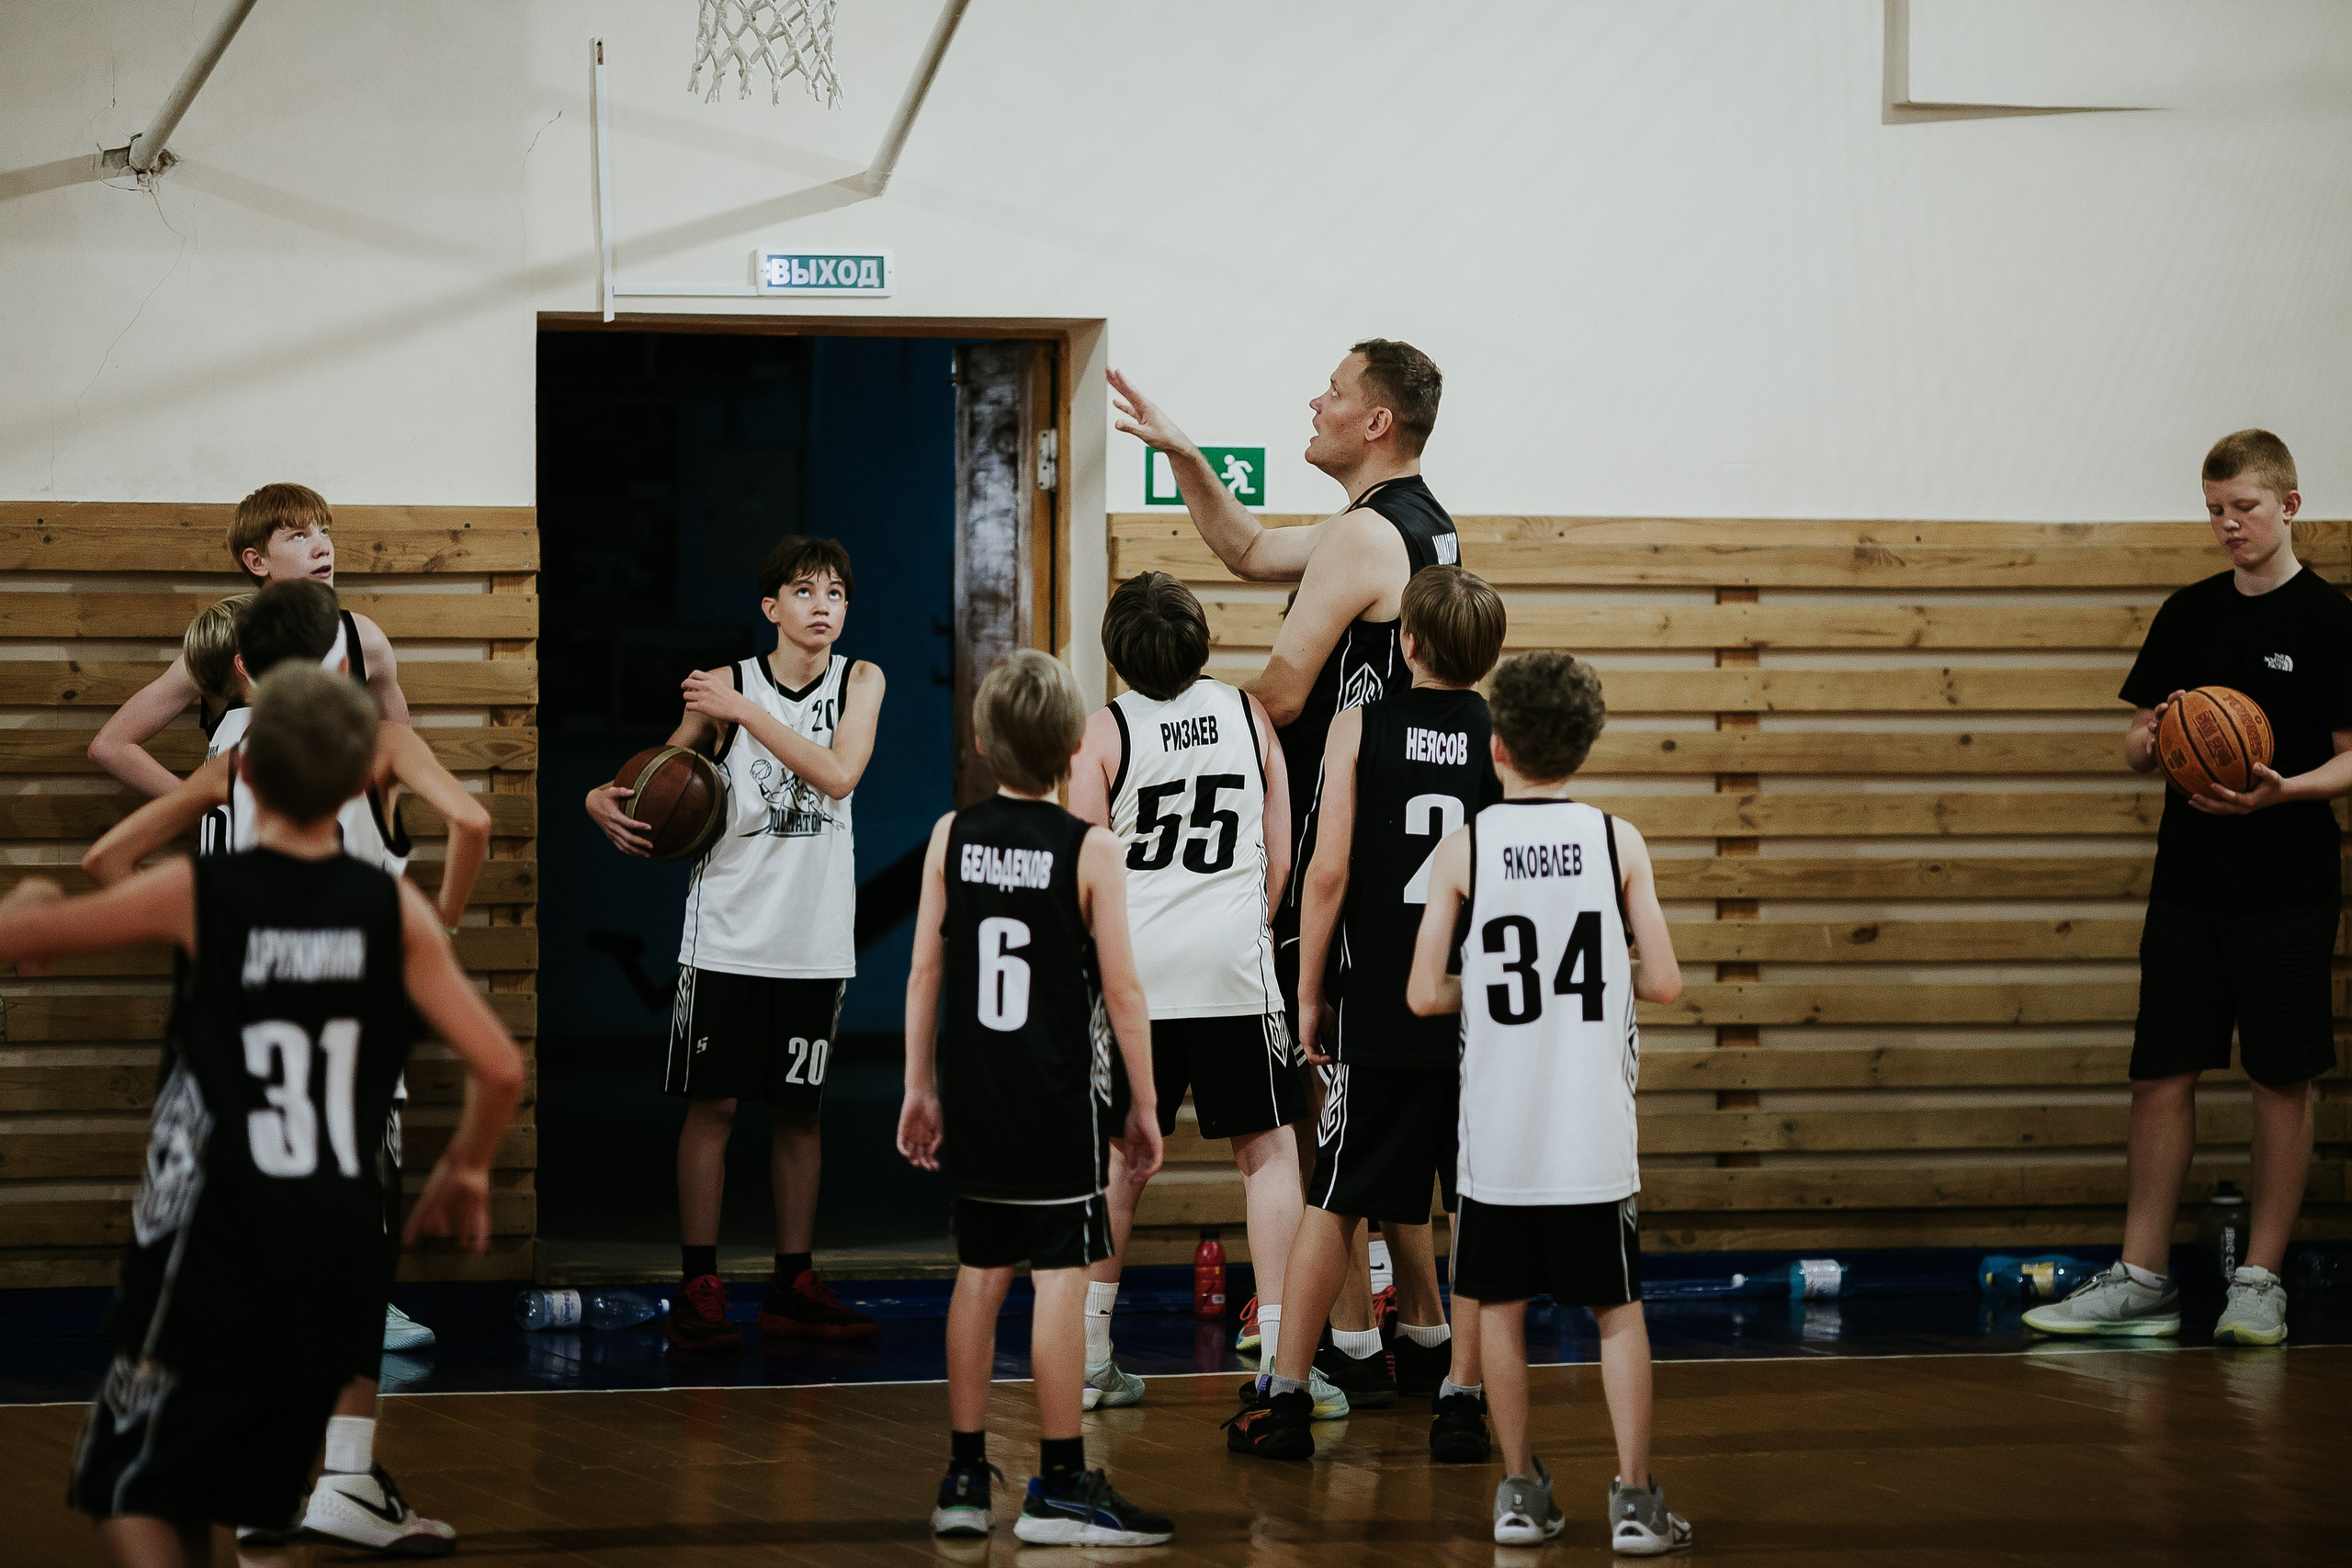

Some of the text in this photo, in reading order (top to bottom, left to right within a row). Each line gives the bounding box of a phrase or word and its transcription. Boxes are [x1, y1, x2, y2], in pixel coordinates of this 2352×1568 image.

[771, 258, 879, 288] ВЫХОД
[1159, 715, 1218, 752] РИЗАЕВ
[1406, 727, 1467, 765] НЕЯСОВ
[1126, 773, 1245, 874] 55
[1404, 794, 1464, 903] 2
[1503, 844, 1582, 879] ЯКОВЛЕВ
[978, 917, 1031, 1032] 6
[1482, 911, 1606, 1025] 34
[242, 1018, 362, 1179] 31
[786, 1037, 828, 1086] 20
